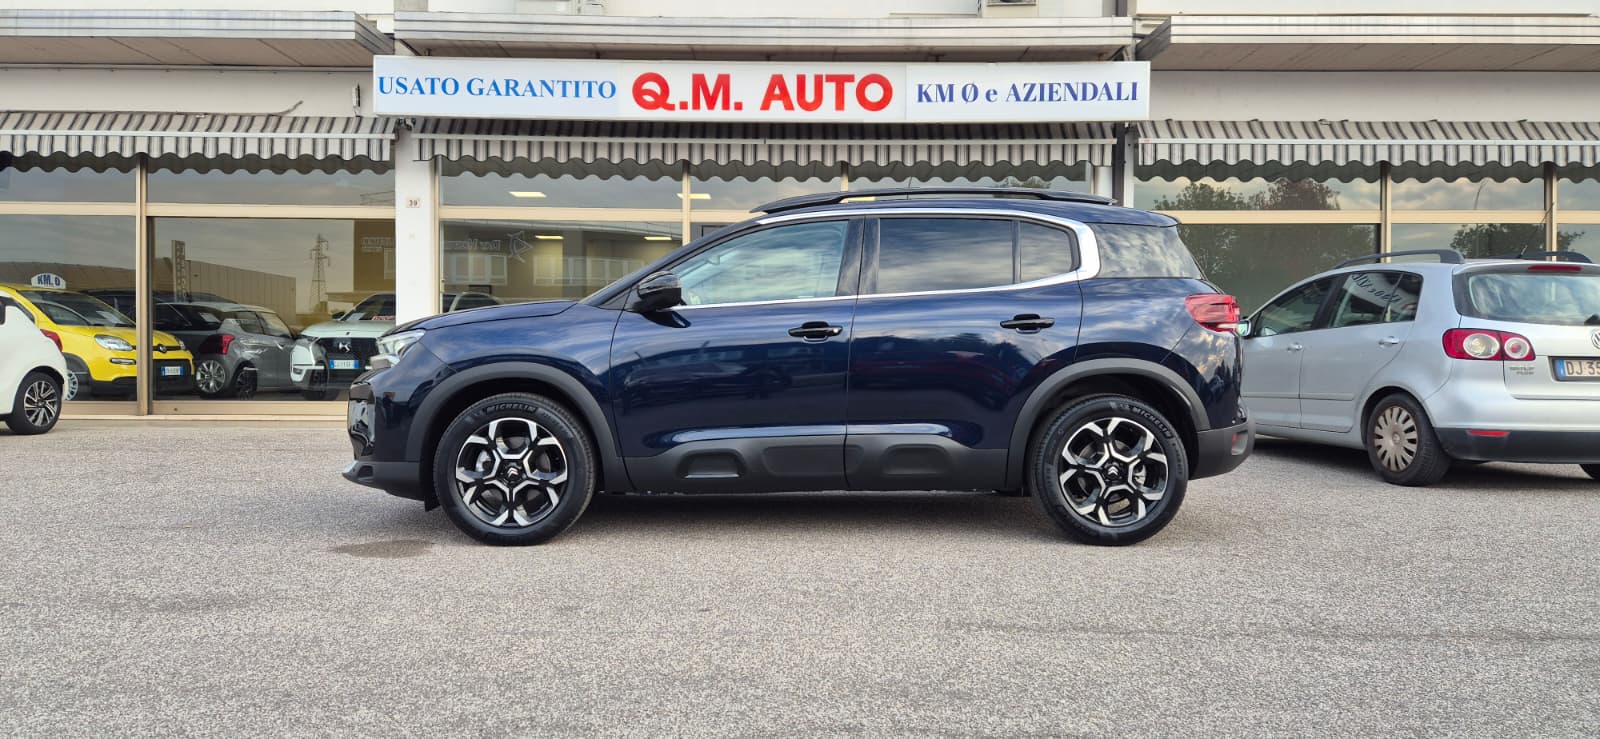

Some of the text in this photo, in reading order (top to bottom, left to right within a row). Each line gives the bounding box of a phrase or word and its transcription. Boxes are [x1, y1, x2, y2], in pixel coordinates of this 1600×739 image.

[378, 76, 617, 99] USATO GARANTITO
[632, 72, 893, 111] Q.M. AUTO
[917, 83, 954, 103] KM
[985, 89, 998, 102] e
[1006, 81, 1138, 102] AZIENDALI
[1566, 361, 1583, 375] DJ
[486, 403, 536, 413] MICHELIN
[1132, 406, 1173, 437] MICHELIN
